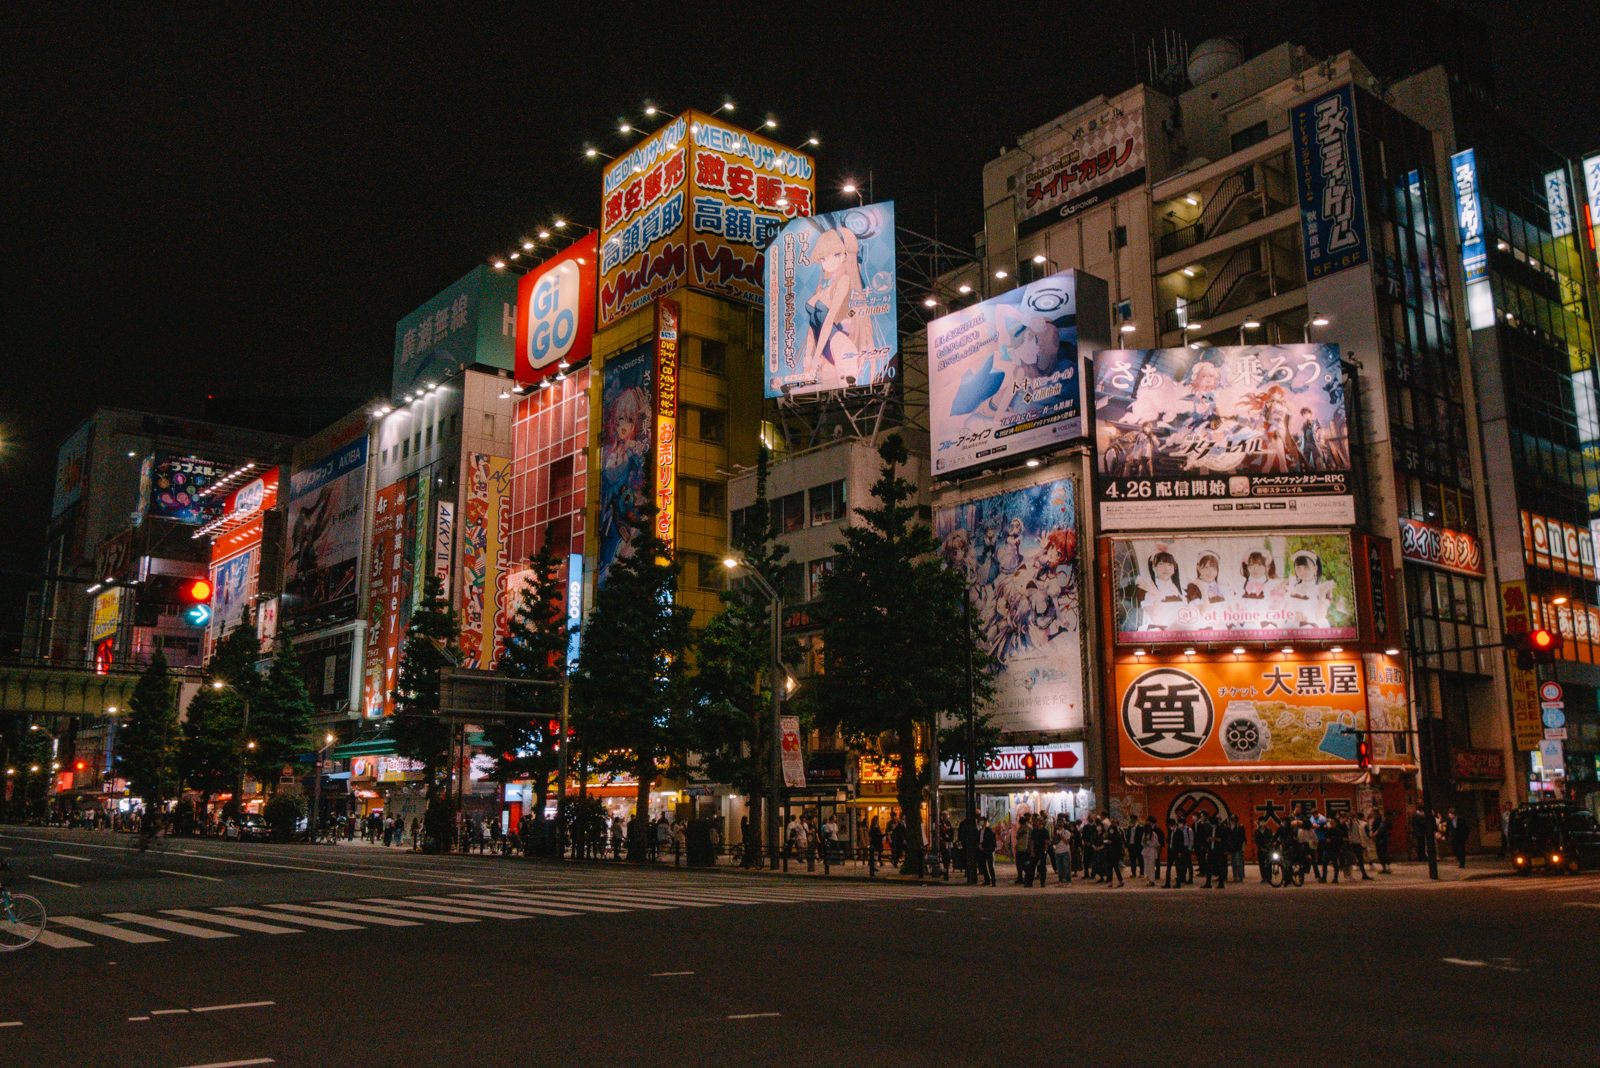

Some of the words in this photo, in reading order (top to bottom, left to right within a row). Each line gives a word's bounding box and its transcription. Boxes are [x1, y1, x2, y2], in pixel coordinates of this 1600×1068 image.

[604, 116, 687, 196] MEDIAリサイクル
[694, 120, 814, 181] MEDIAリサイクル
[602, 147, 686, 234] 激安販売
[694, 149, 813, 219] 激安販売
[601, 191, 684, 277] 高額買取
[600, 241, 687, 323] Mulan
[660, 340, 676, 351] DVD
[1106, 481, 1152, 499] 4.26
[1155, 480, 1227, 498] 配信開始
[1402, 522, 1481, 571] メイドカジノ
[1217, 686, 1259, 698] チケット
[1262, 663, 1360, 696] 大黒屋
[1134, 682, 1205, 749] 質
